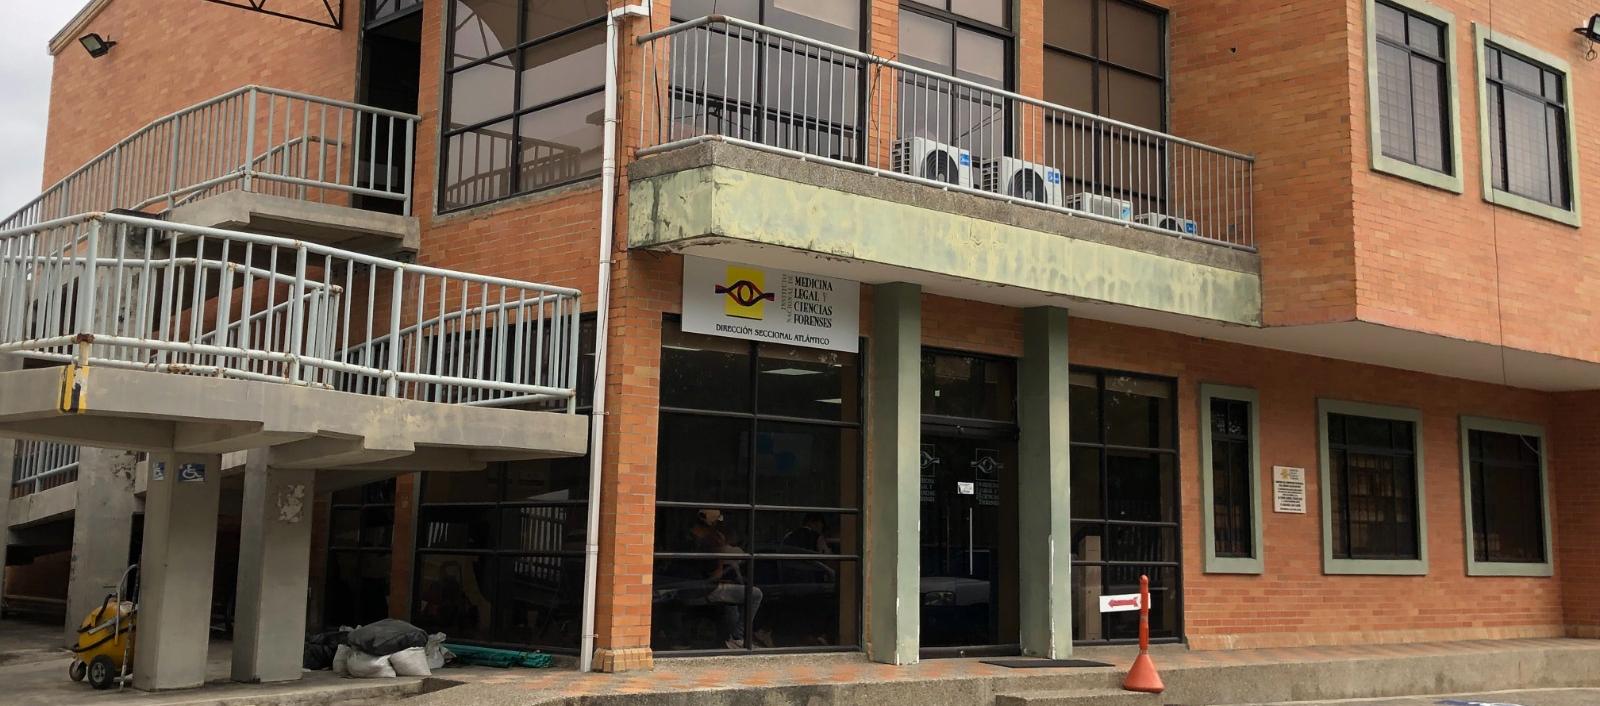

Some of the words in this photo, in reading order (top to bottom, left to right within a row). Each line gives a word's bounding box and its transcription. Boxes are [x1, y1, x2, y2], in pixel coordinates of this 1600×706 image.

[795, 275, 833, 291] MEDICINA
[794, 288, 819, 302] LEGAL
[794, 301, 833, 316] CIENCIAS
[793, 313, 832, 328] FORENSES
[716, 323, 752, 335] DIRECCIÓN
[754, 328, 792, 340] SECCIONAL
[793, 334, 829, 345] ATLÁNTICO
